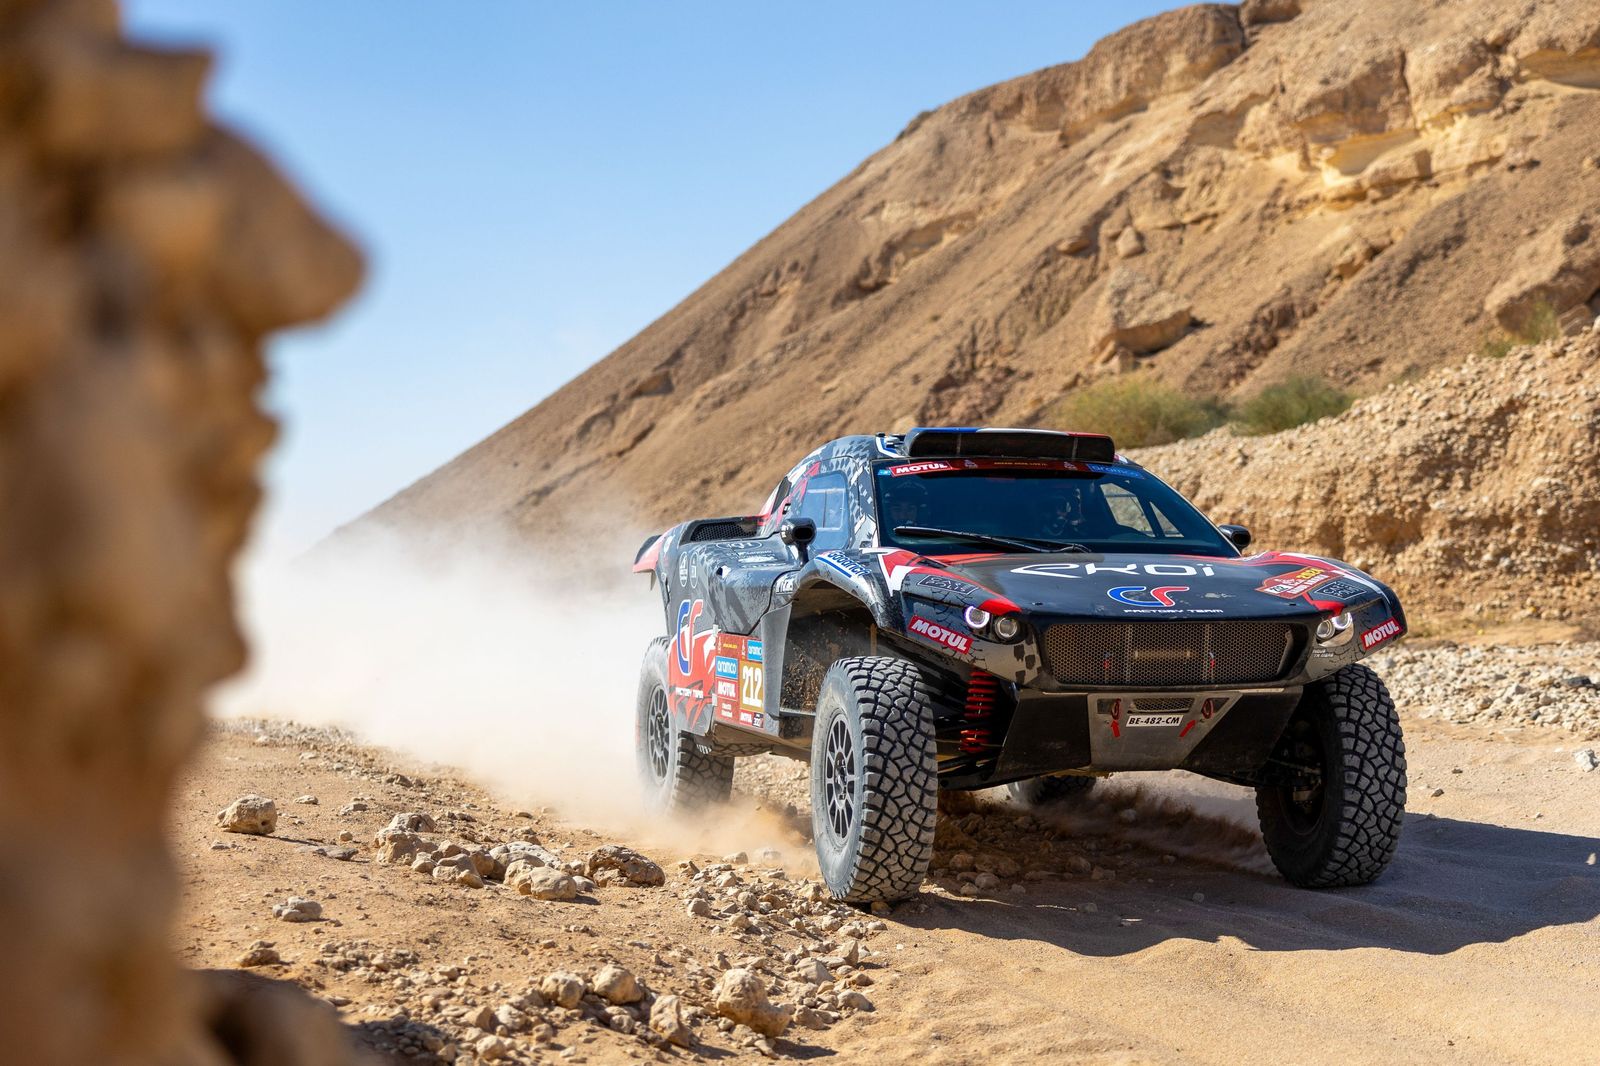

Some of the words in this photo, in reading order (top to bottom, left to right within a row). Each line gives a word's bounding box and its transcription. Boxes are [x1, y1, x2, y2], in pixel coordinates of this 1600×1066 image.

[896, 463, 948, 474] MOTUL
[911, 619, 969, 651] MOTUL
[1364, 620, 1400, 647] MOTUL
[717, 660, 737, 675] aramco
[717, 681, 736, 698] MOTUL
[742, 665, 763, 708] 212
[1128, 717, 1181, 725] BE-482-CM
